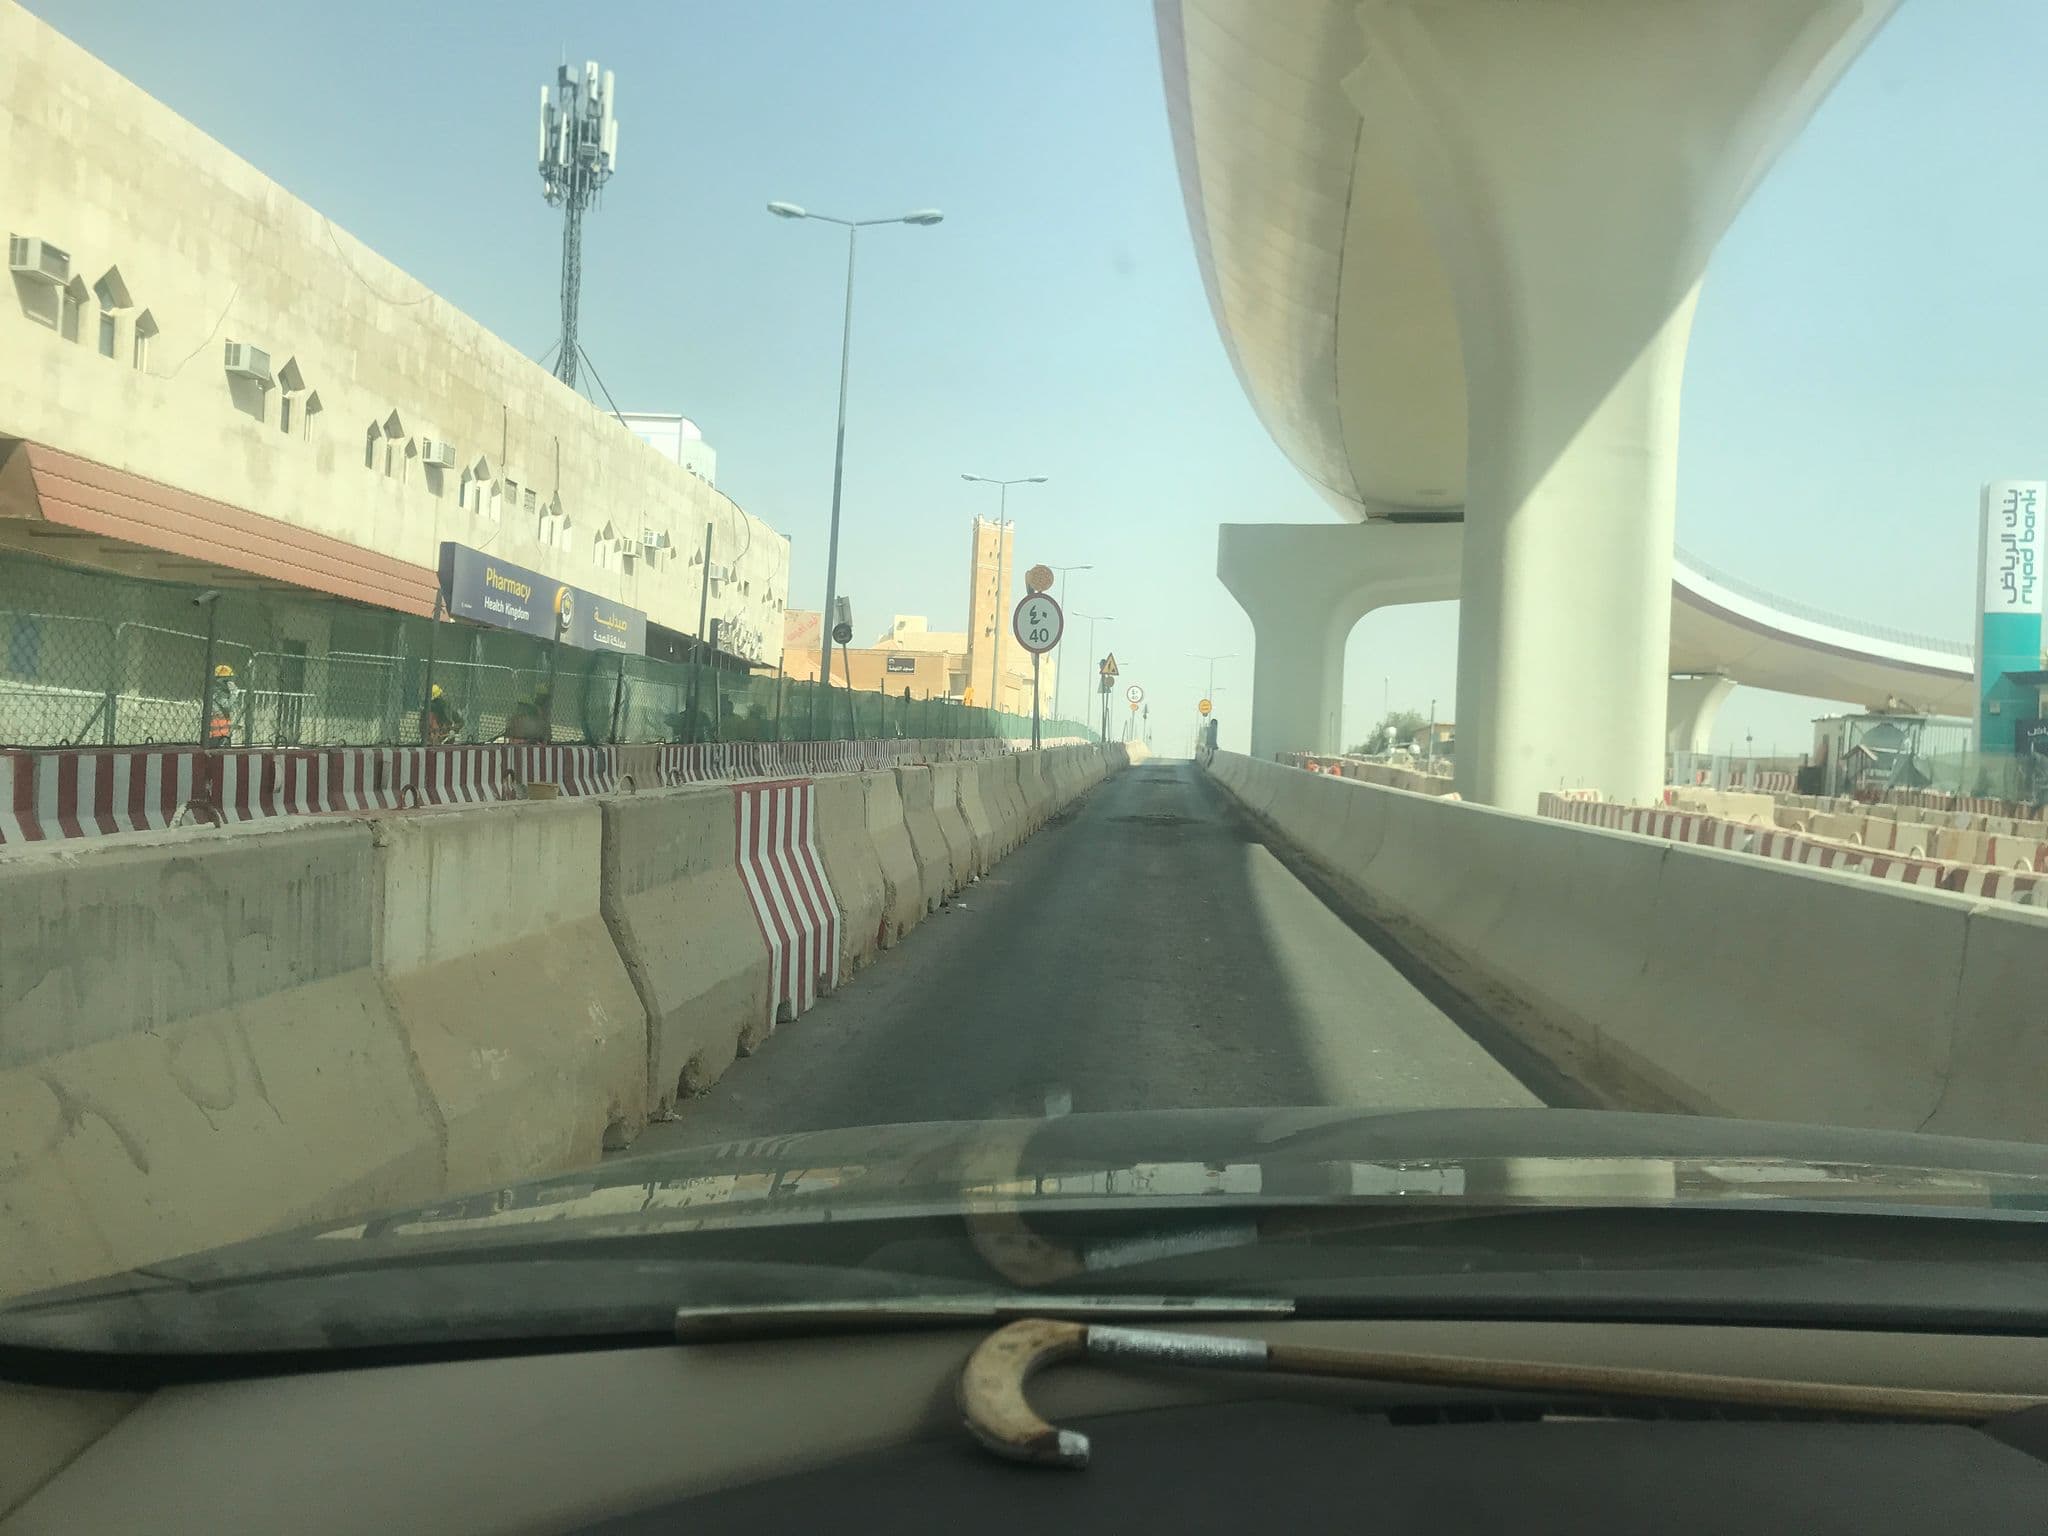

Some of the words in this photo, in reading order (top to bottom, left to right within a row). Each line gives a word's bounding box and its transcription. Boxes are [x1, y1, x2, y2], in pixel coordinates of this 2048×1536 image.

[2002, 489, 2022, 528] بنك
[2018, 489, 2037, 542] bank
[2000, 533, 2020, 604] الرياض
[2019, 548, 2037, 604] riyad
[486, 567, 531, 604] Pharmacy
[484, 596, 504, 613] Health
[505, 602, 529, 620] Kingdom
[593, 606, 627, 632] صيدلية
[1029, 605, 1047, 625] ٤٠
[610, 634, 626, 649] مملكة
[1029, 628, 1049, 643] 40
